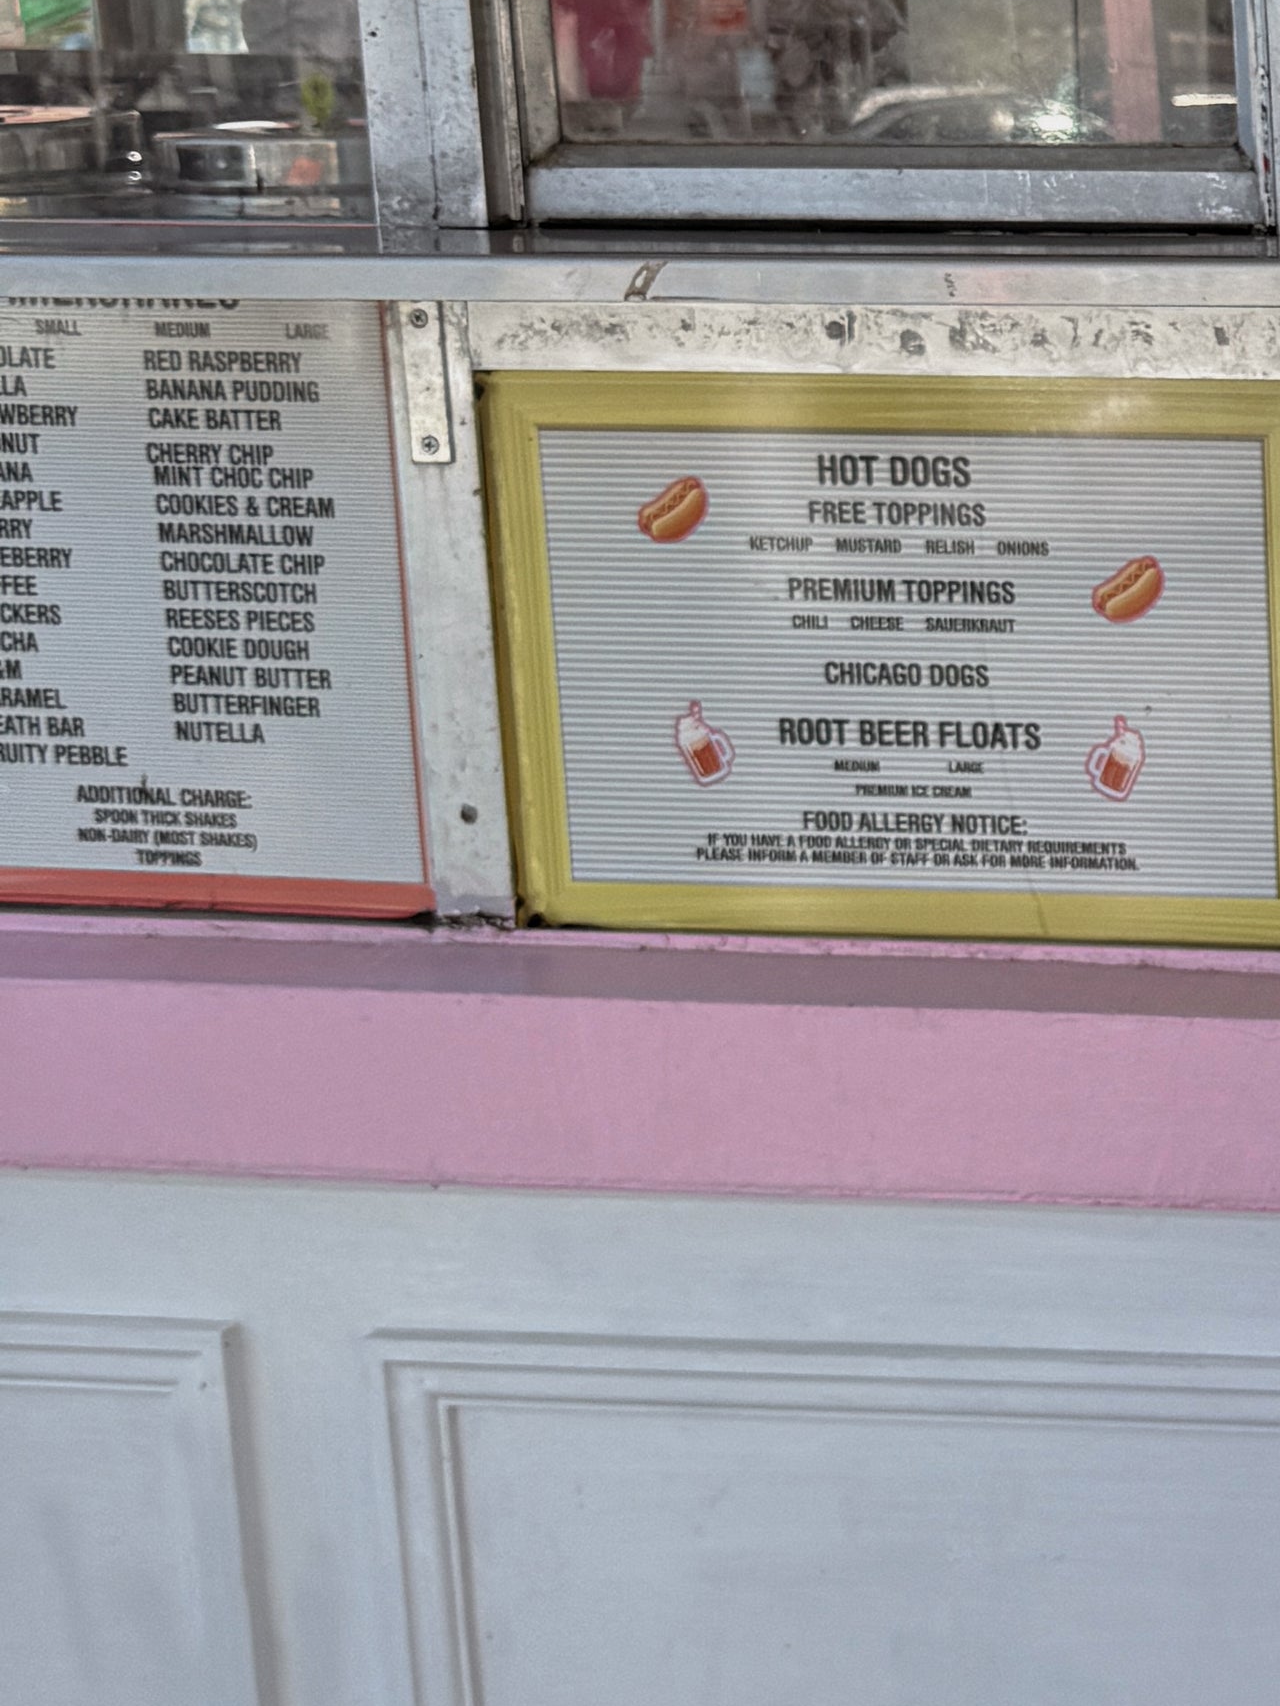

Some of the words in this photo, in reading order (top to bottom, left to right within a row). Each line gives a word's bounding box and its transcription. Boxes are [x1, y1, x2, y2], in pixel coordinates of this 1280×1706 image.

[36, 319, 82, 336] SMALL
[155, 322, 211, 338] MEDIUM
[285, 323, 330, 340] LARGE
[144, 350, 182, 372] RED
[188, 351, 301, 374] RASPBERRY
[146, 379, 227, 401] BANANA
[232, 381, 320, 403] PUDDING
[149, 408, 200, 430] CAKE
[205, 409, 282, 431] BATTER
[146, 442, 222, 465] CHERRY
[229, 444, 274, 466] CHIP
[154, 465, 203, 487] MINT
[211, 467, 263, 488] CHOC
[269, 468, 314, 489] CHIP
[817, 454, 879, 486] HOT
[890, 455, 971, 488] DOGS
[156, 493, 239, 516] COOKIES
[247, 496, 260, 517] &
[267, 496, 336, 519] CREAM
[808, 500, 866, 524] FREE
[873, 502, 986, 526] TOPPINGS
[159, 522, 314, 547] MARSHMALLOW
[750, 536, 813, 552] KETCHUP
[836, 537, 902, 553] MUSTARD
[926, 539, 975, 556] RELISH
[997, 540, 1049, 557] ONIONS
[161, 551, 275, 574] CHOCOLATE
[281, 554, 325, 576] CHIP
[163, 579, 318, 604] BUTTERSCOTCH
[788, 577, 896, 603] PREMIUM
[901, 579, 1016, 605] TOPPINGS
[166, 608, 240, 631] REESES
[246, 610, 315, 633] PIECES
[792, 615, 829, 631] CHILI
[851, 615, 904, 631] CHEESE
[926, 617, 1016, 634] SAUERKRAUT
[167, 636, 238, 659] COOKIE
[243, 638, 310, 660] DOUGH
[171, 664, 248, 687] PEANUT
[254, 667, 332, 690] BUTTER
[824, 661, 922, 687] CHICAGO
[928, 663, 990, 688] DOGS
[173, 692, 320, 718] BUTTERFINGER
[48, 717, 85, 738] BAR
[175, 720, 265, 744] NUTELLA
[778, 718, 850, 745] ROOT
[859, 719, 930, 748] BEER
[938, 721, 1042, 751] FLOATS
[55, 746, 128, 767] PEBBLE
[833, 760, 881, 773] MEDIUM
[948, 761, 985, 774] LARGE
[77, 784, 177, 806] ADDITIONAL
[855, 784, 908, 797] PREMIUM
[911, 785, 929, 798] ICE
[932, 786, 973, 799] CREAM
[94, 808, 138, 825] SPOON
[142, 809, 182, 826] THICK
[184, 811, 237, 829] SHAKES
[803, 810, 852, 831] FOOD
[858, 812, 944, 834] ALLERGY
[951, 814, 1028, 836] NOTICE:
[78, 827, 150, 844] NON-DAIRY
[153, 829, 195, 848] (MOST
[200, 831, 257, 853] SHAKES)
[707, 832, 720, 846] IF
[723, 833, 747, 846] YOU
[751, 834, 783, 847] HAVE
[786, 835, 796, 847] A
[799, 835, 832, 849] FOOD
[834, 836, 892, 850] ALLERGY
[894, 838, 913, 850] OR
[916, 838, 968, 853] SPECIAL
[971, 840, 1025, 853] DIETARY
[1027, 841, 1127, 855] REQUIREMENTS
[135, 849, 202, 867] TOPPINGS
[697, 847, 745, 862] PLEASE
[748, 849, 797, 862] INFORM
[800, 850, 810, 863] A
[812, 850, 867, 864] MEMBER
[870, 851, 887, 865] OF
[890, 852, 929, 866] STAFF
[934, 853, 951, 867] OR
[954, 853, 980, 867] ASK
[982, 854, 1007, 868] FOR
[1010, 854, 1046, 869] MORE
